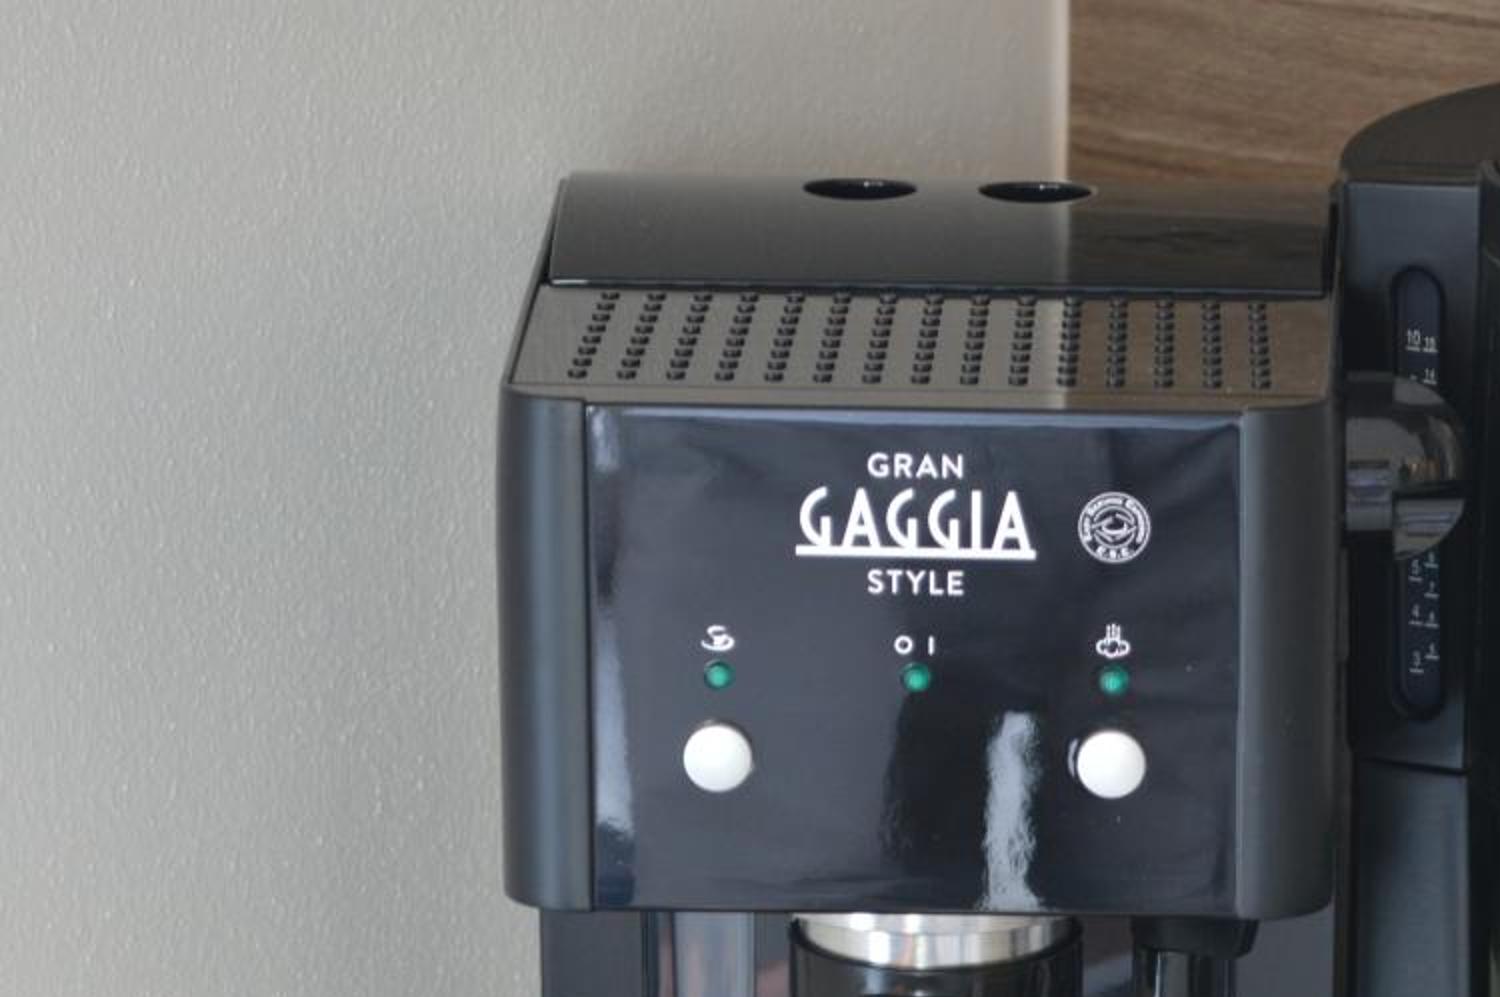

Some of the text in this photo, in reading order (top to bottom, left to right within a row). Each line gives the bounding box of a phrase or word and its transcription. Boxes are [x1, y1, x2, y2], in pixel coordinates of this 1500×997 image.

[867, 452, 964, 479] GRAN
[798, 486, 1036, 560] GAGGIA
[867, 568, 964, 596] STYLE
